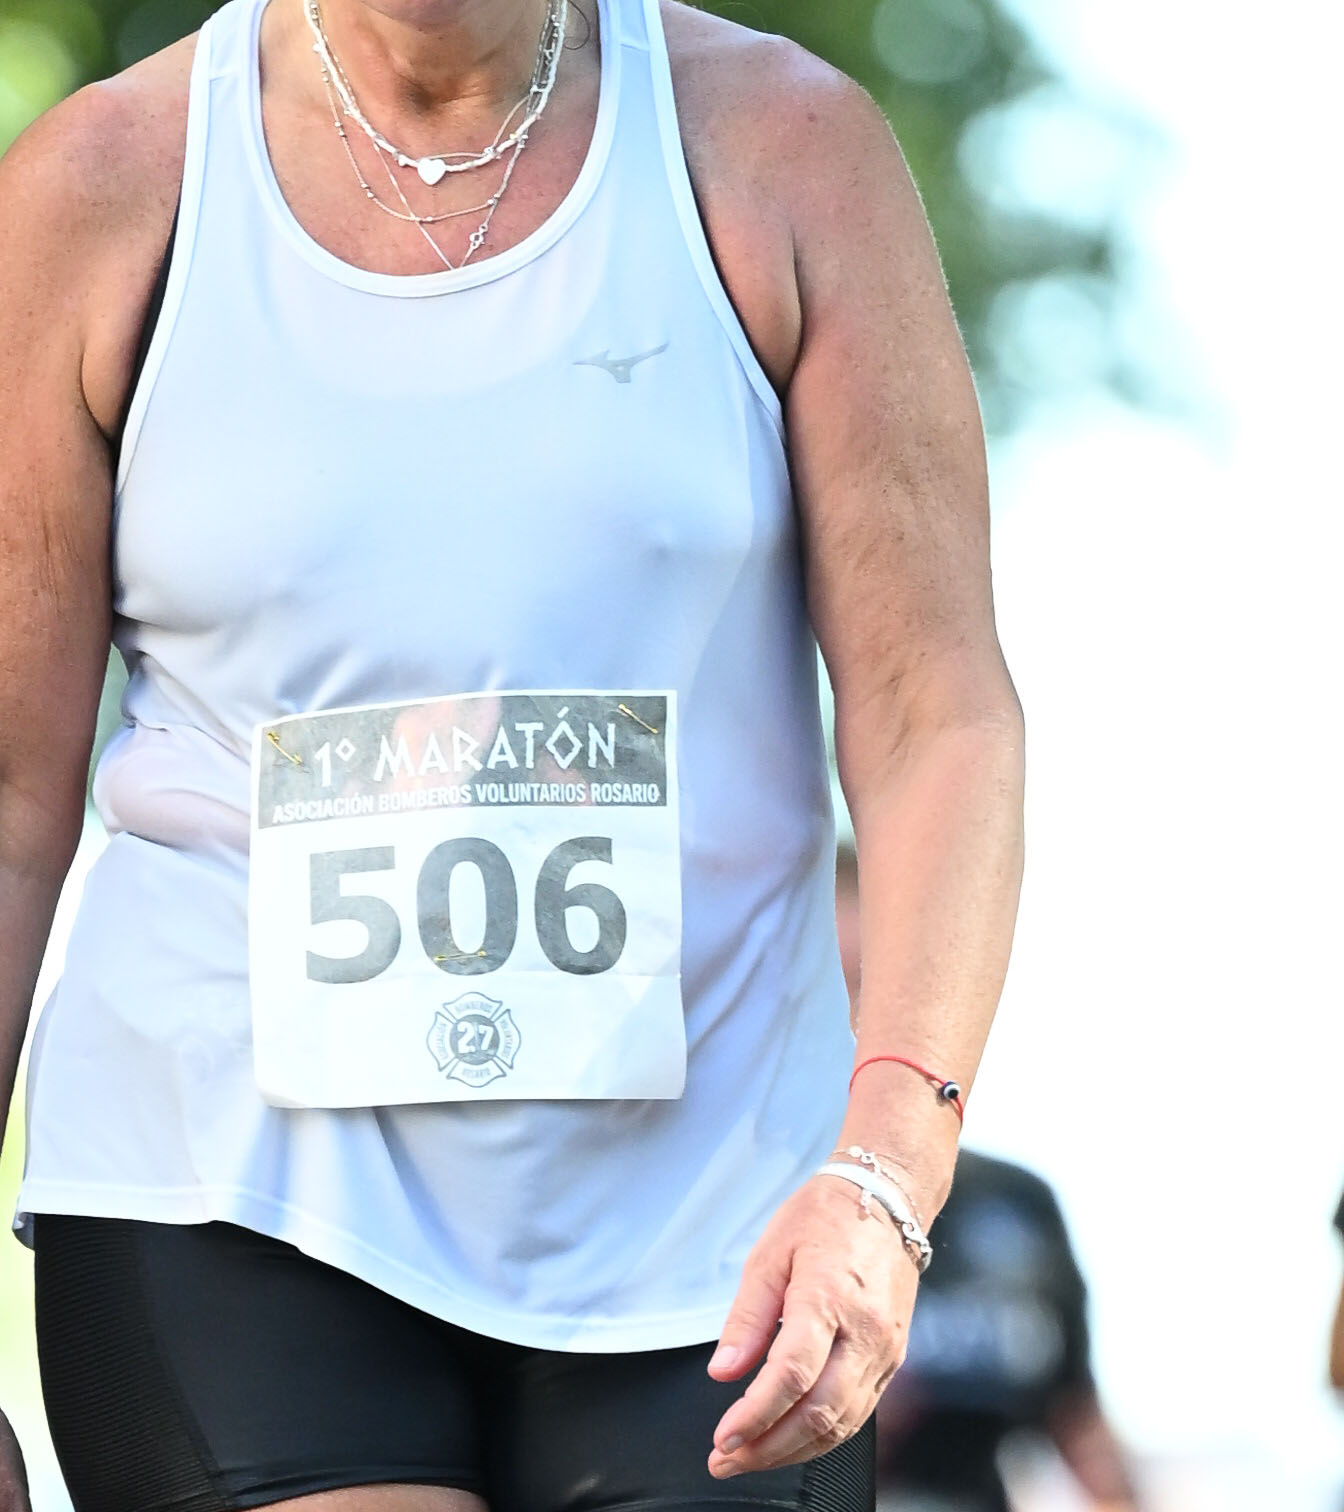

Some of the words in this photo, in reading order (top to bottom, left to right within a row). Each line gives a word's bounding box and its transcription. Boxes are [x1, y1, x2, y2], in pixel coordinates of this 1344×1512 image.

[372, 705, 617, 782] MARATÓN
[271, 791, 375, 825] ASOCIACIÓN
[378, 784, 473, 813] BOMBEROS
[475, 782, 587, 804] VOLUNTARIOS
[590, 782, 661, 804] ROSARIO
[305, 835, 628, 985] 506
[456, 1020, 495, 1054] 27
